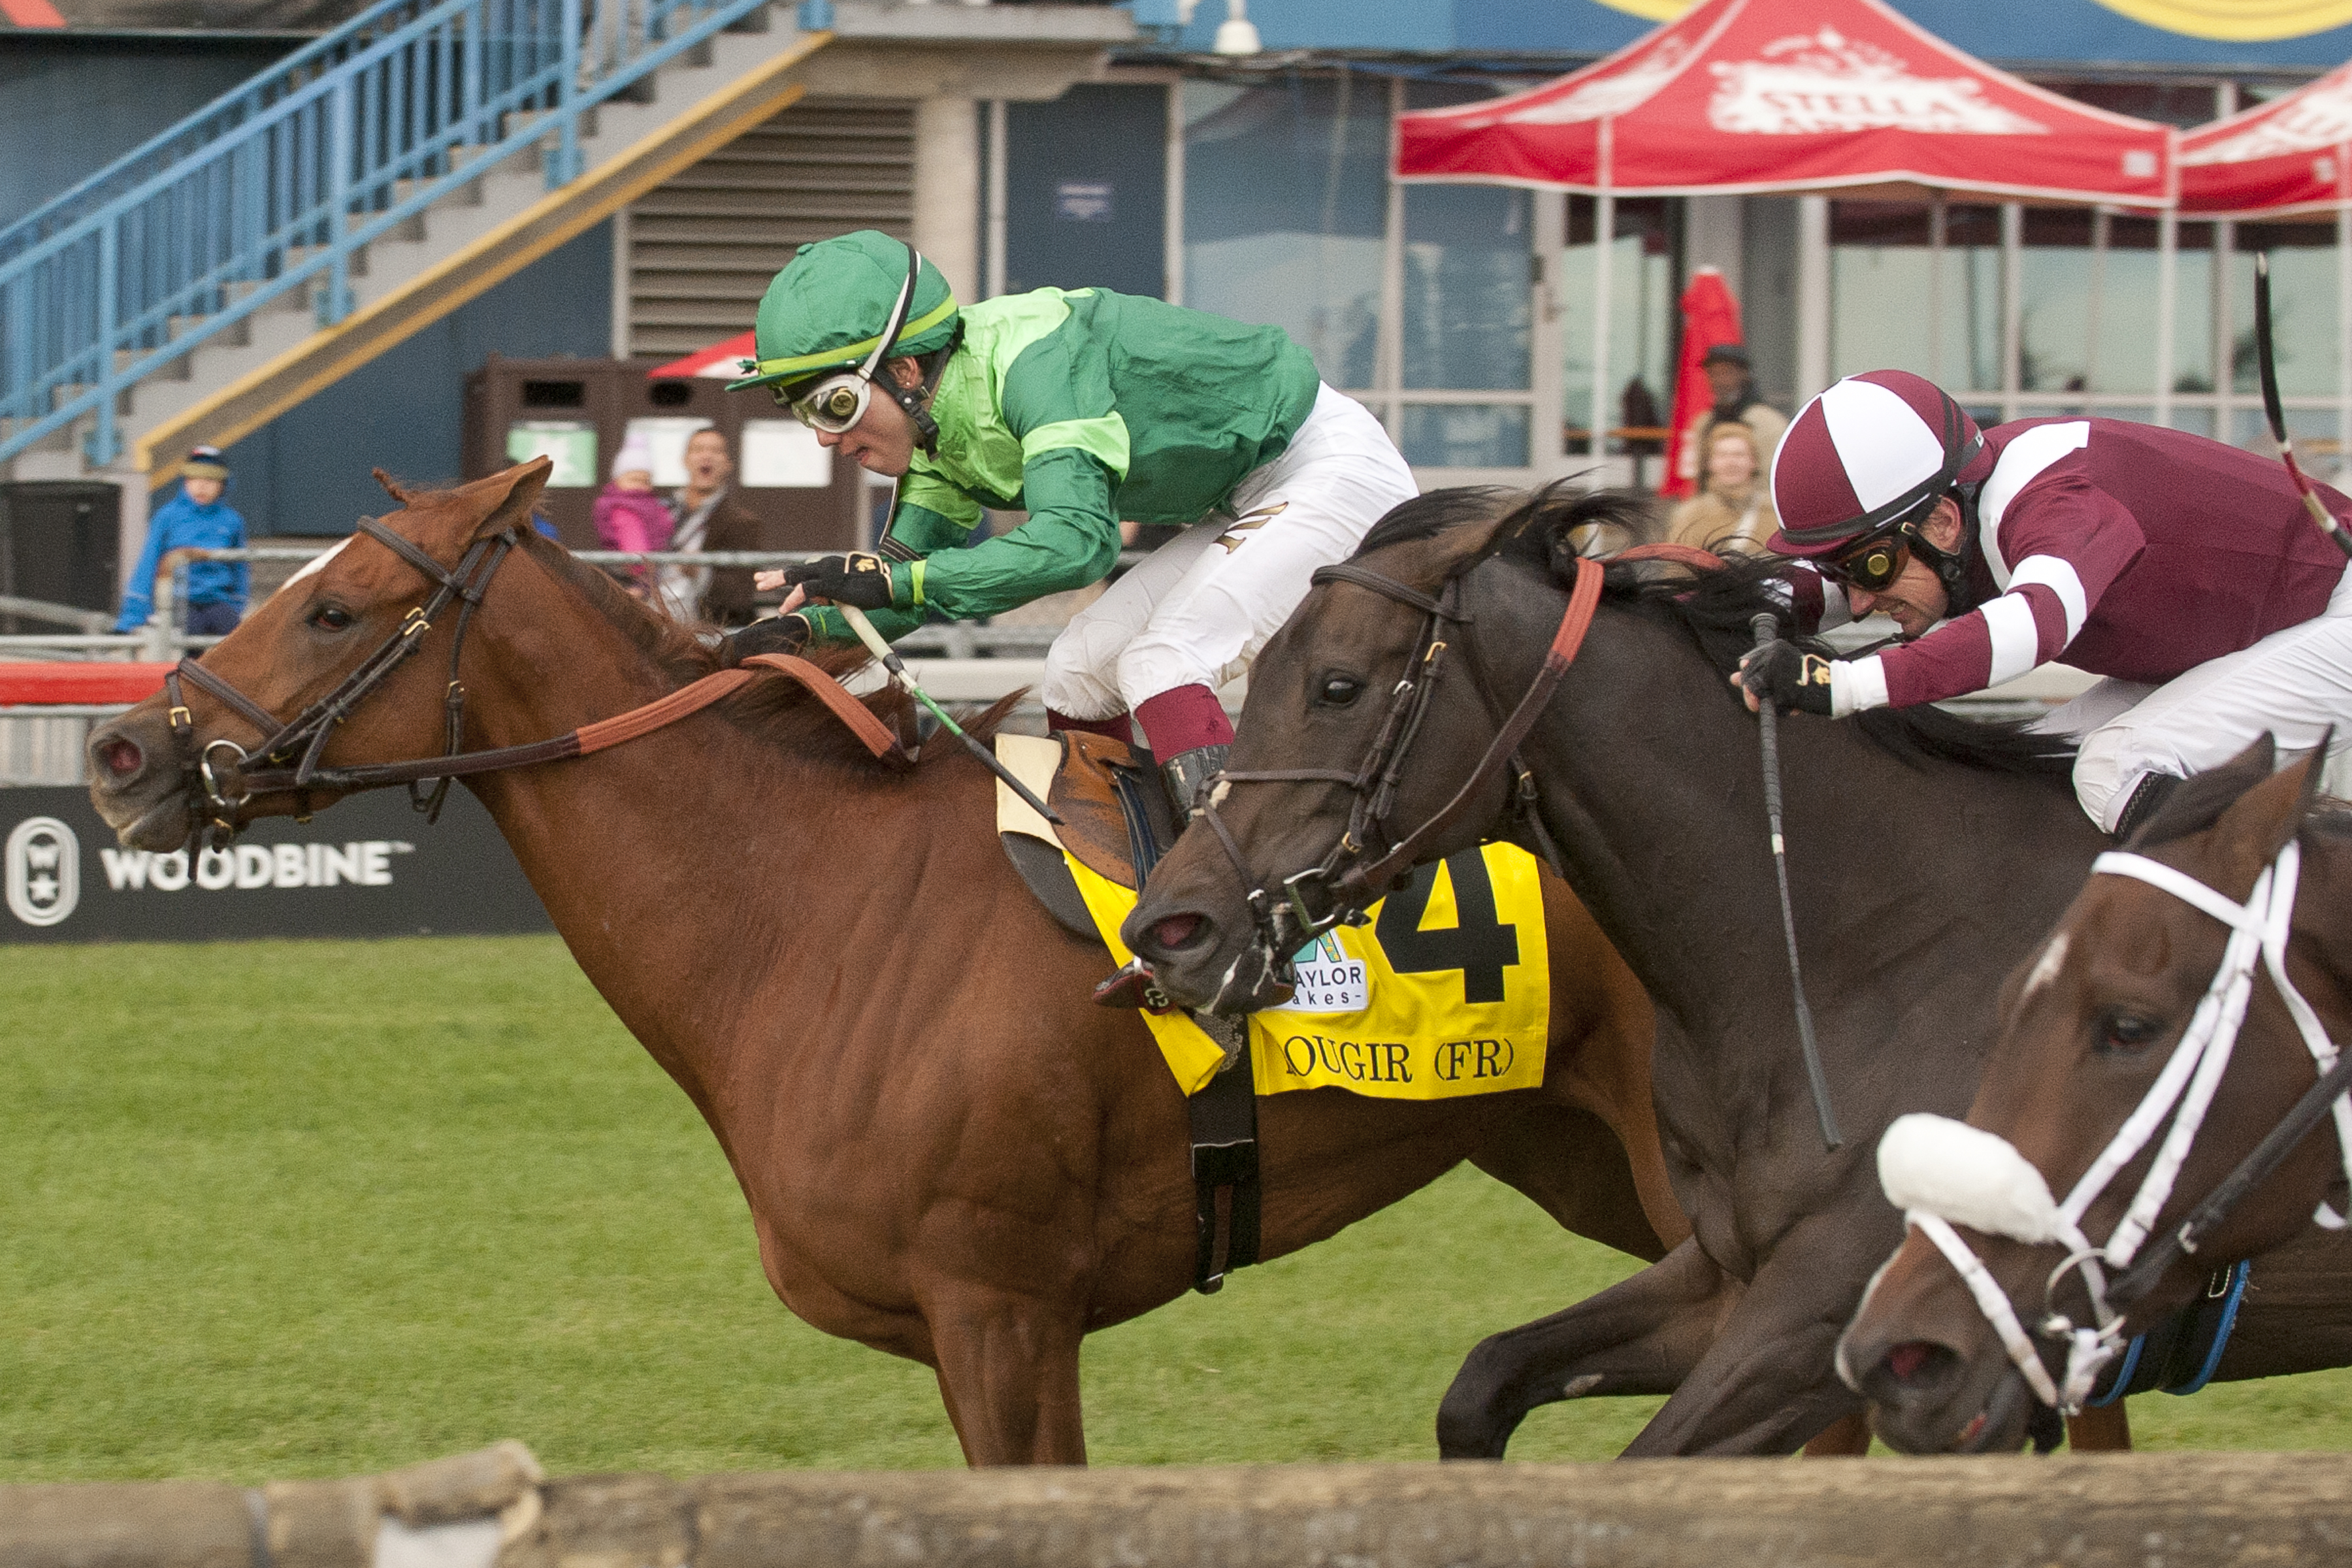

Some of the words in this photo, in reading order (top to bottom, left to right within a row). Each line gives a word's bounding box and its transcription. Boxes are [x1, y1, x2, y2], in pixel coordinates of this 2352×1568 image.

[99, 841, 393, 890] WOODBINE
[1374, 845, 1521, 1004] 4
[1296, 966, 1362, 988] AYLOR
[1284, 1035, 1413, 1083] OUGIR
[1434, 1038, 1514, 1081] (FR)
